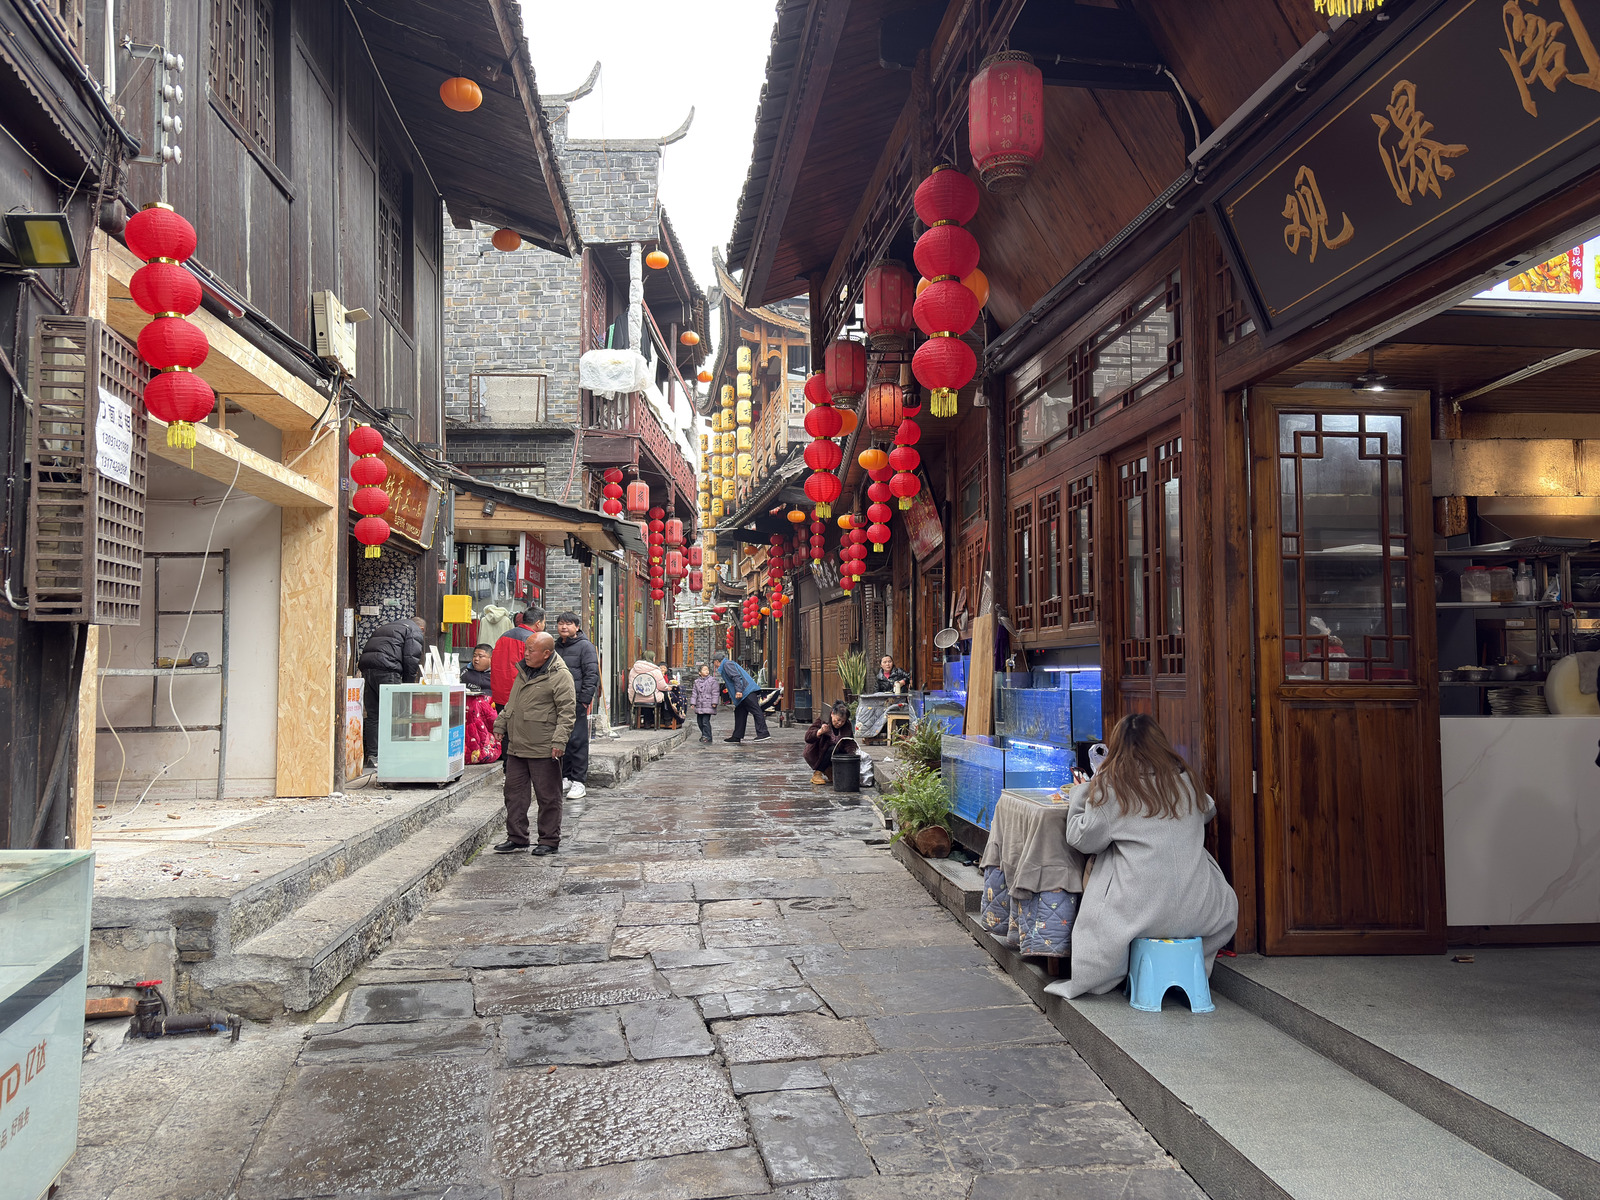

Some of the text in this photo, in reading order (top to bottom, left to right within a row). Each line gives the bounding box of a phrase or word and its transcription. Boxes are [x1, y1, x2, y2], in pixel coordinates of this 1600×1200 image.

[99, 399, 132, 434] 门面出租
[25, 1038, 47, 1086] 亿达
